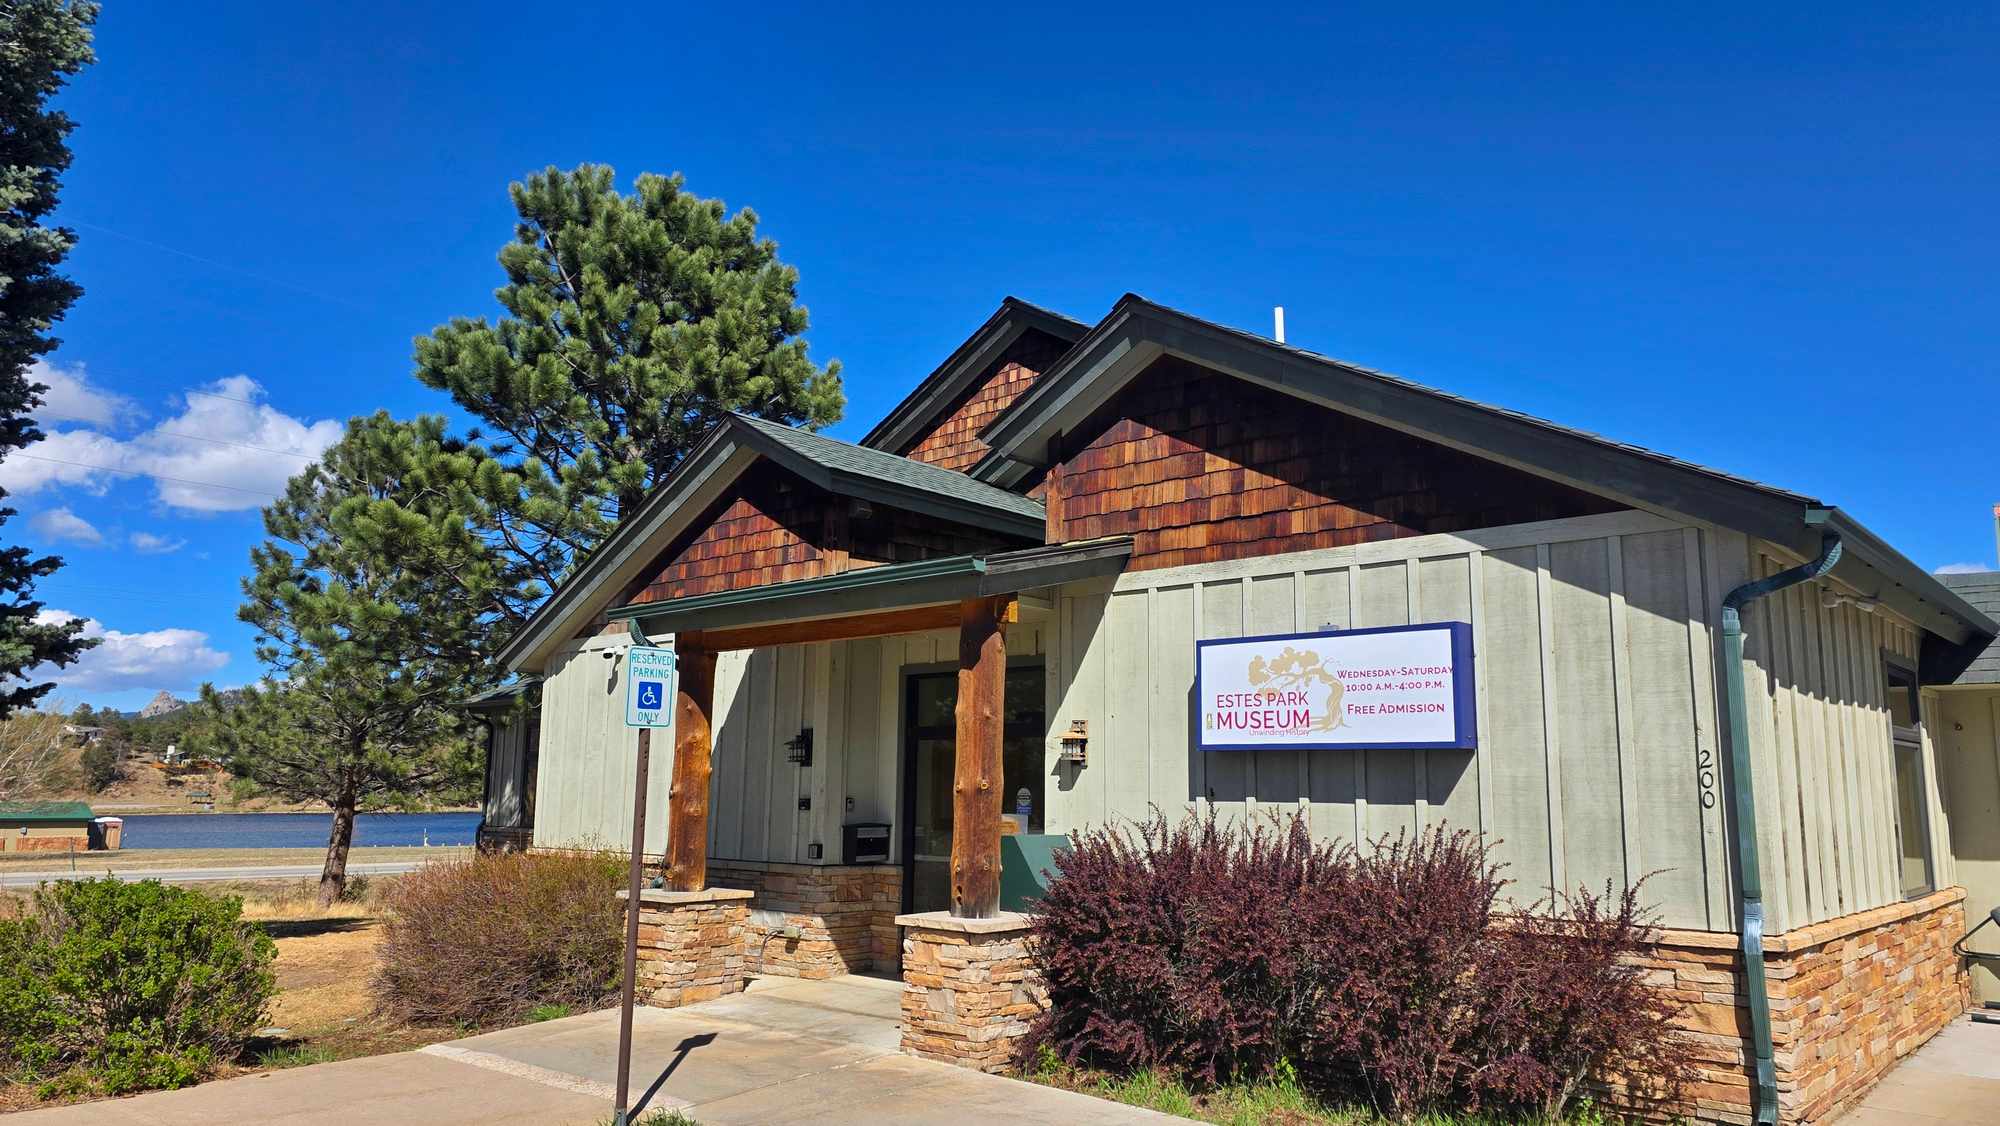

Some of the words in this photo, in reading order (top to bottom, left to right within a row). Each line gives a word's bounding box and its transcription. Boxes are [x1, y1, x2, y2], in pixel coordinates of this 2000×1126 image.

[632, 653, 671, 665] RESERVED
[634, 667, 669, 679] PARKING
[1346, 683, 1372, 692] 10:00
[1375, 682, 1422, 690] A.M.-4:00
[1425, 681, 1445, 689] P.M.
[1217, 693, 1262, 708] ESTES
[1267, 691, 1308, 706] PARK
[1347, 704, 1375, 715] FREE
[1380, 703, 1445, 714] ADMISSION
[638, 712, 659, 723] ONLY
[1217, 709, 1310, 729] MUSEUM
[1249, 729, 1284, 737] Unwinding
[1286, 728, 1311, 736] History
[1699, 750, 1715, 809] 200
